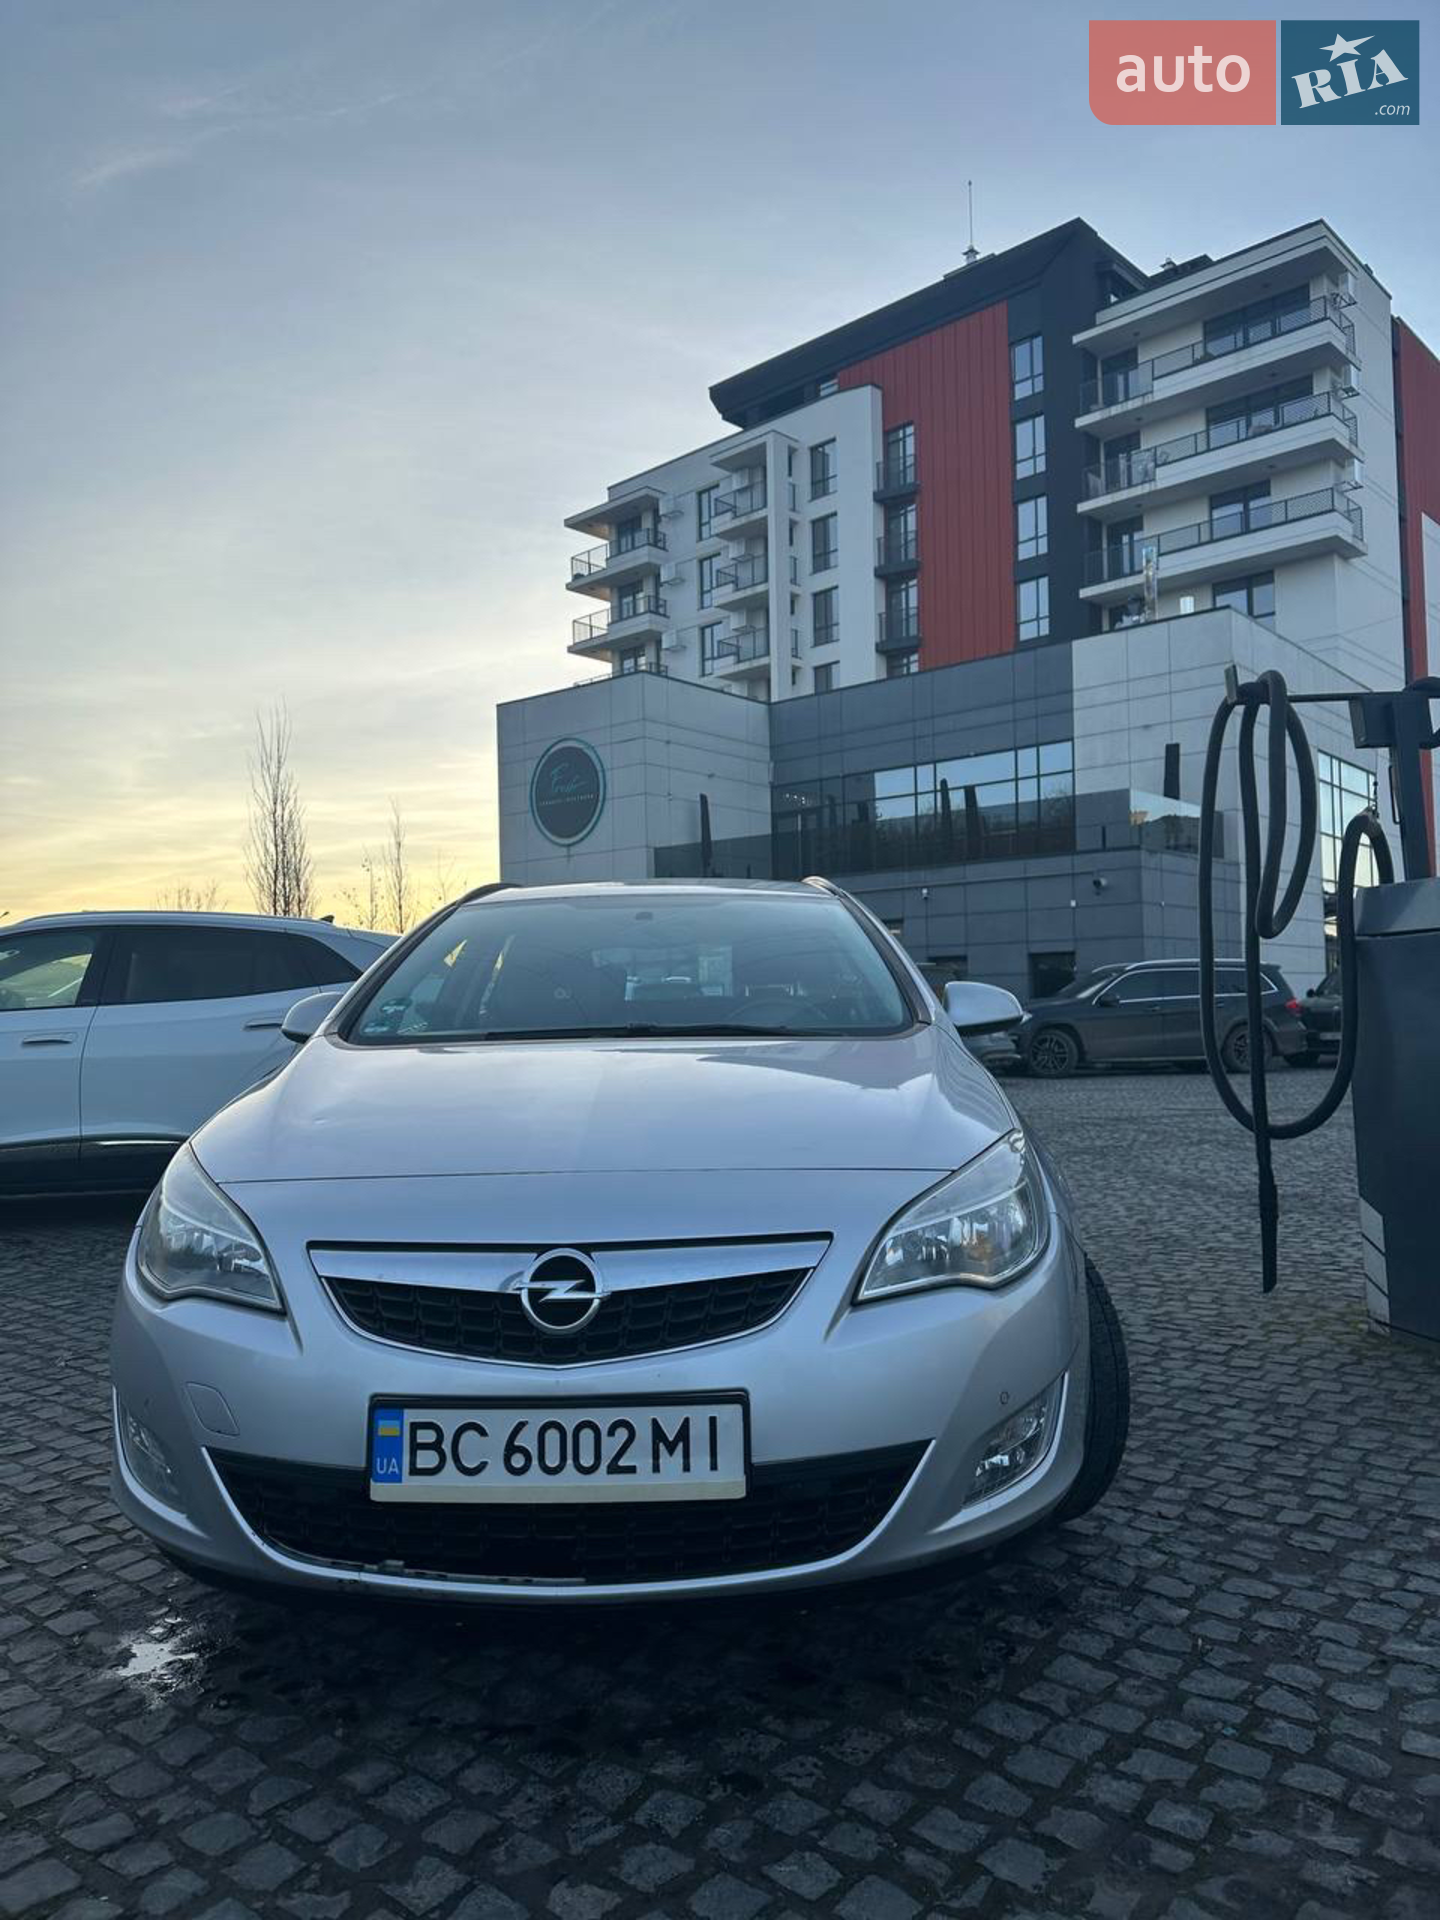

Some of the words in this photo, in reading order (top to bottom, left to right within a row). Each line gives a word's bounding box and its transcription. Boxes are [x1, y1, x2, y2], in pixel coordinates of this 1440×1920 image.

[408, 1421, 489, 1477] BC
[503, 1419, 638, 1477] 6002
[651, 1415, 718, 1474] MI
[375, 1457, 400, 1476] UA
